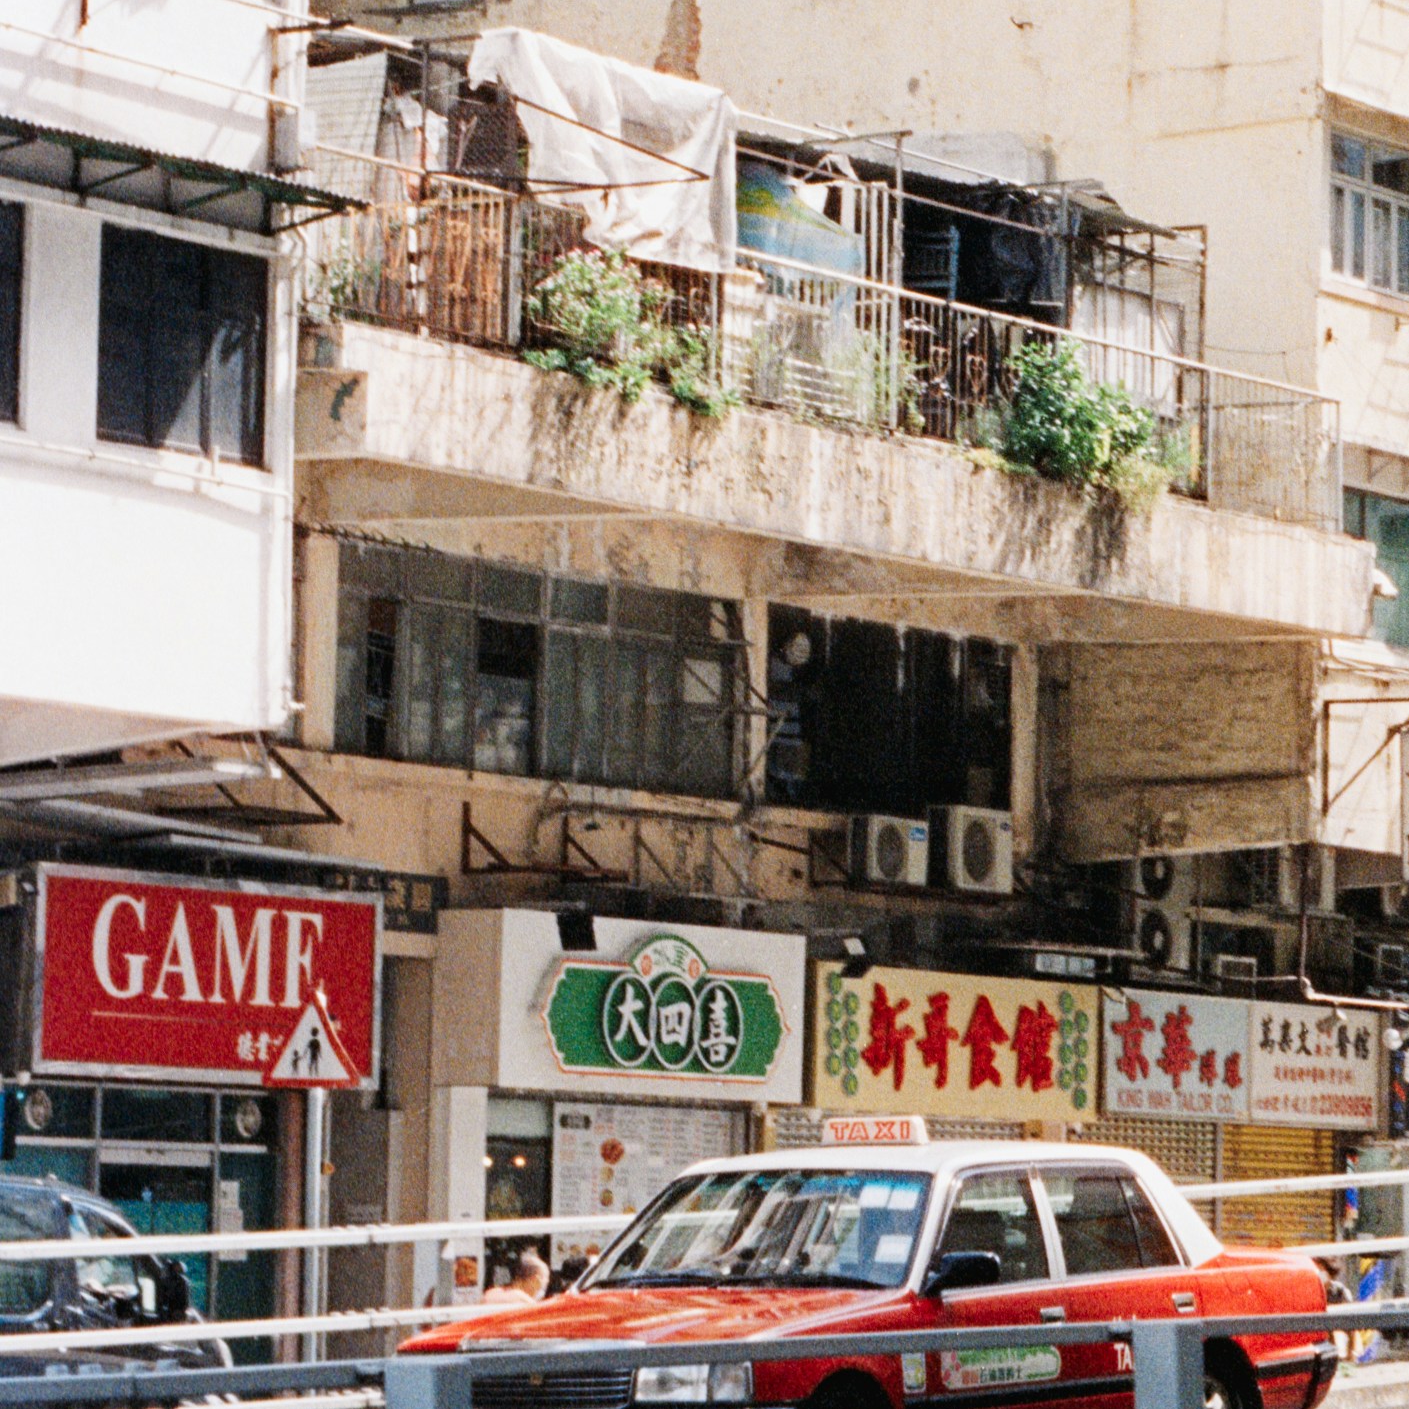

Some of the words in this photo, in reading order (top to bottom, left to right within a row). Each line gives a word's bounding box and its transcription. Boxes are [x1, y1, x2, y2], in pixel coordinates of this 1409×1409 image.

[91, 893, 325, 1008] GAME
[612, 981, 738, 1064] 大四喜
[829, 1120, 912, 1141] TAXI
